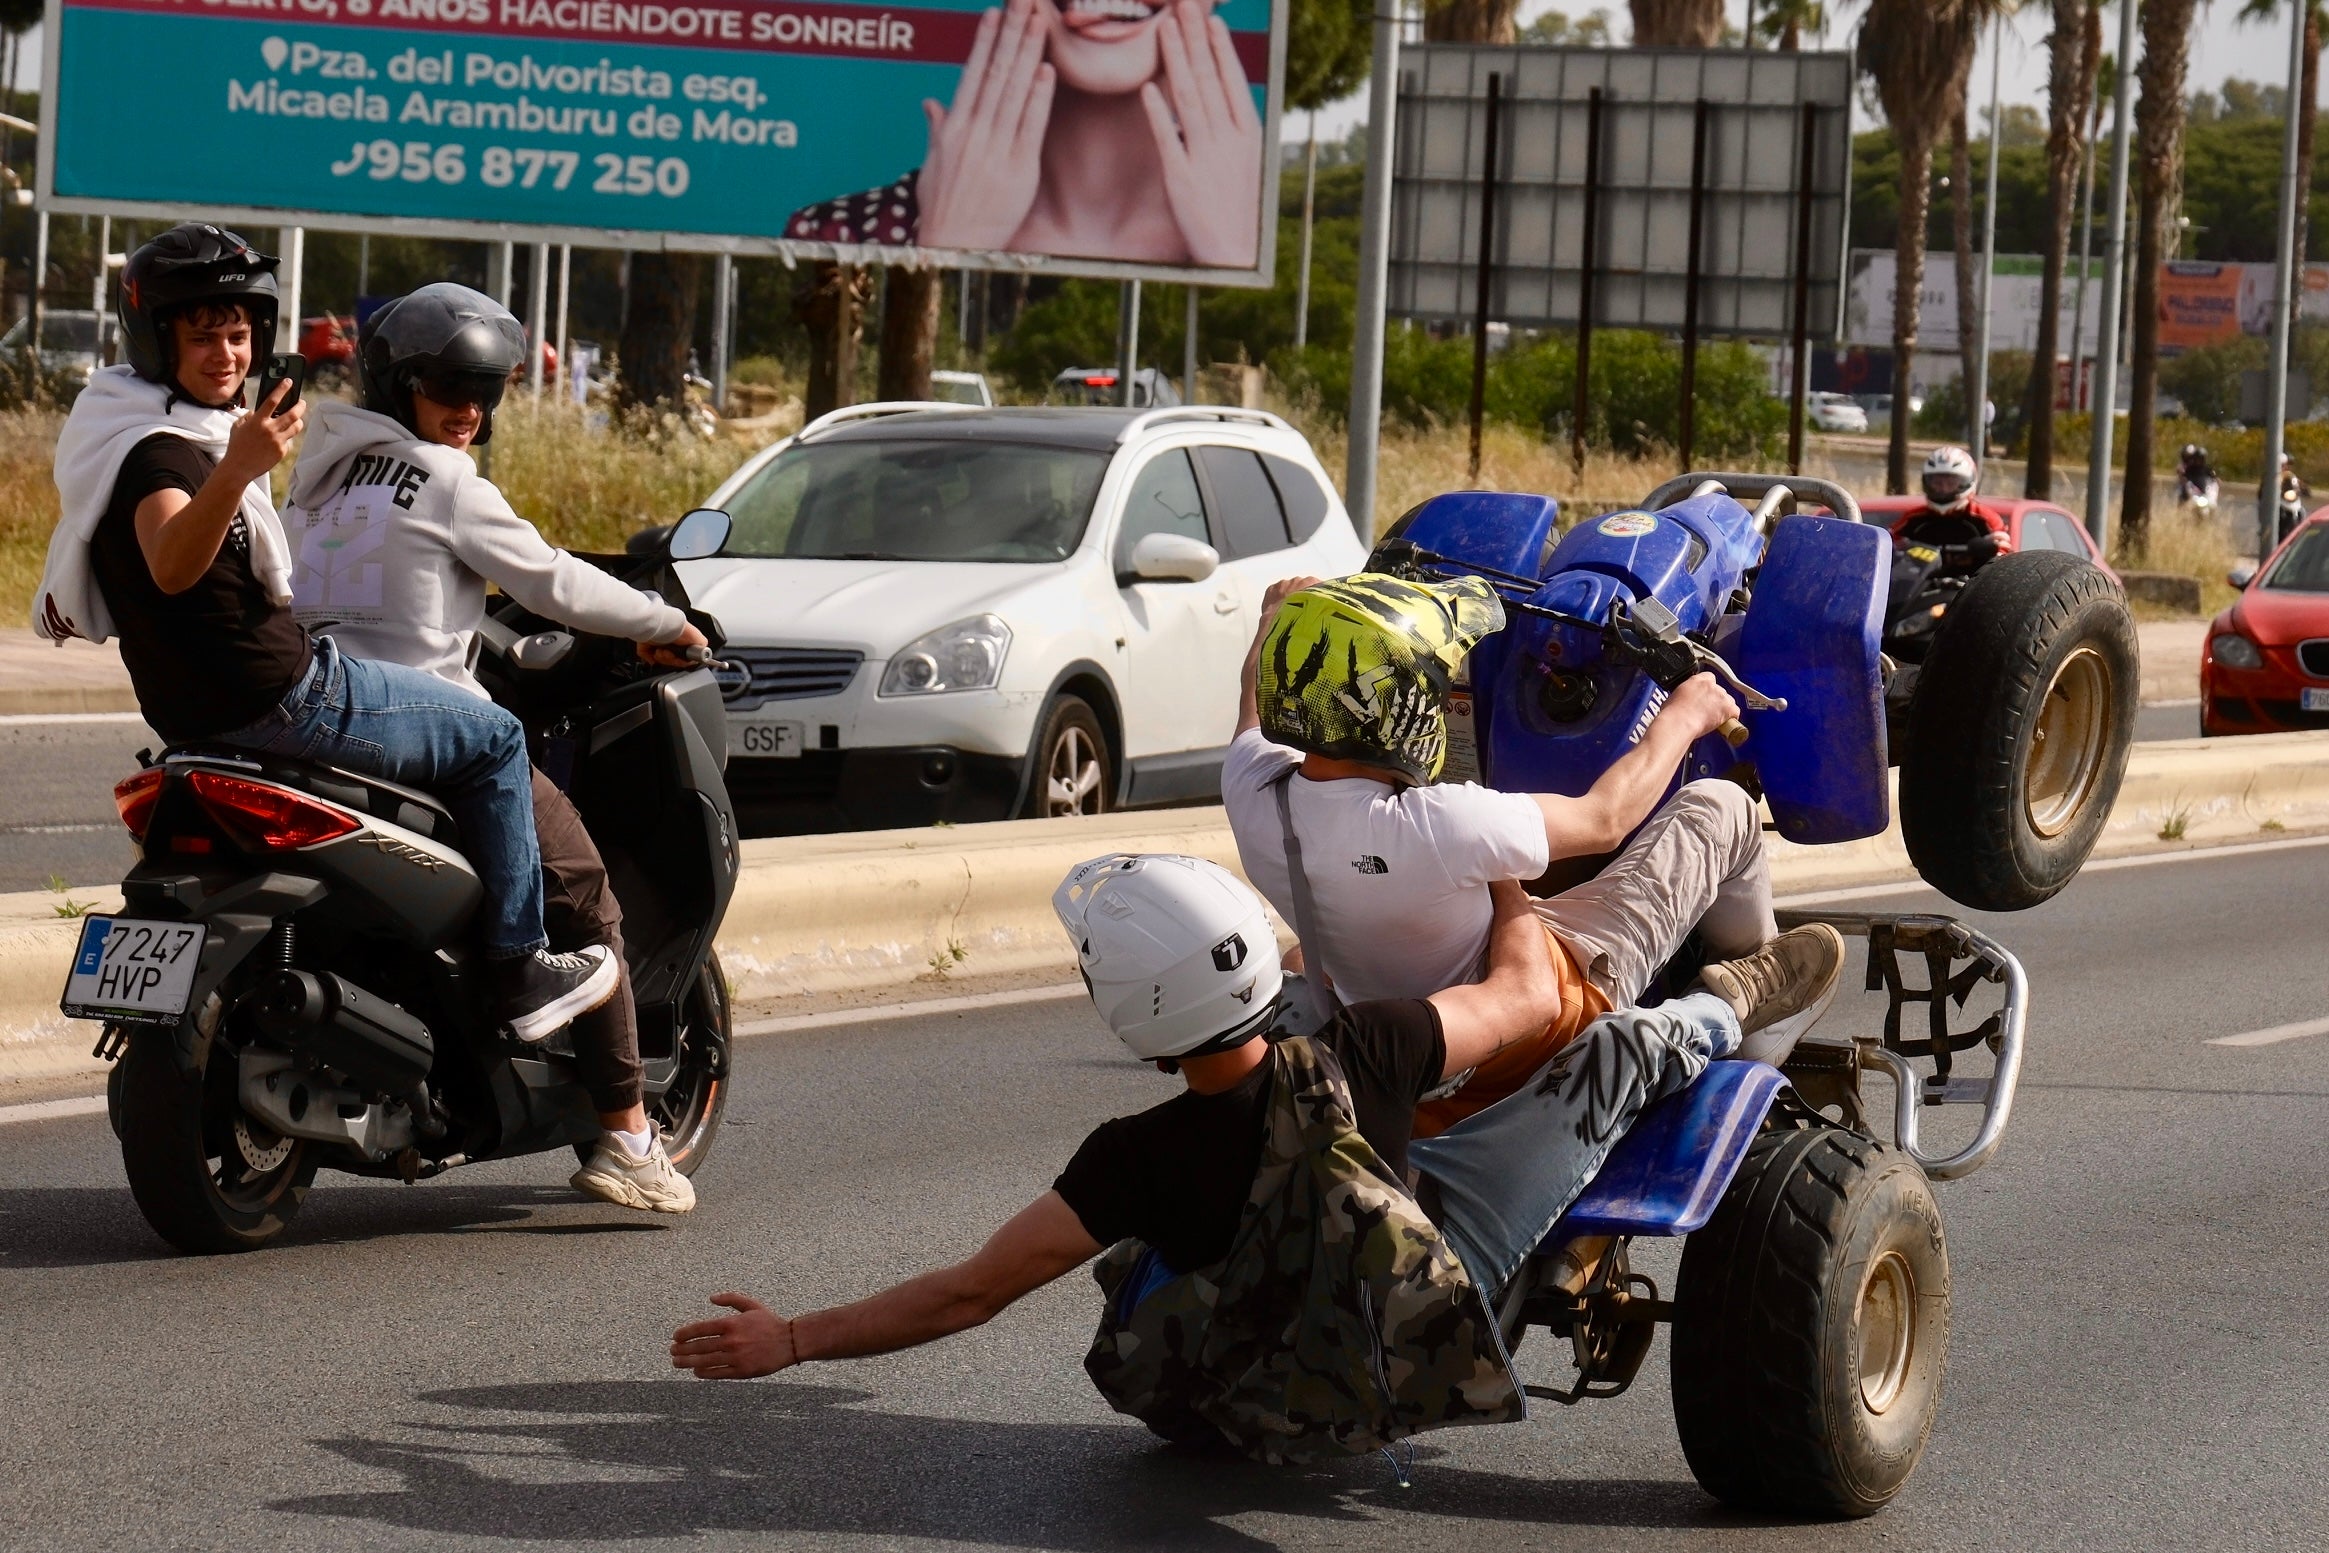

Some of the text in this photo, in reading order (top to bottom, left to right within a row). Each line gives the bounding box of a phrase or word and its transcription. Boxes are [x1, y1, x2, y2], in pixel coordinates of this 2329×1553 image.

[500, 0, 743, 40] HACIÉNDOTE
[750, 13, 914, 50] SONREÍR
[290, 41, 768, 111] Pza. del Polvorista esq.
[227, 78, 799, 148] Micaela Aramburu de Mora
[367, 138, 691, 198] 956 877 250
[218, 273, 246, 283] UFO
[1628, 687, 1669, 745] YAMAH
[743, 726, 789, 751] GSF
[1351, 860, 1375, 868] NORTH
[1358, 867, 1376, 875] FACE
[1360, 854, 1373, 862] THE
[83, 952, 97, 966] E
[104, 926, 195, 965] 7247
[96, 963, 162, 1002] HVP
